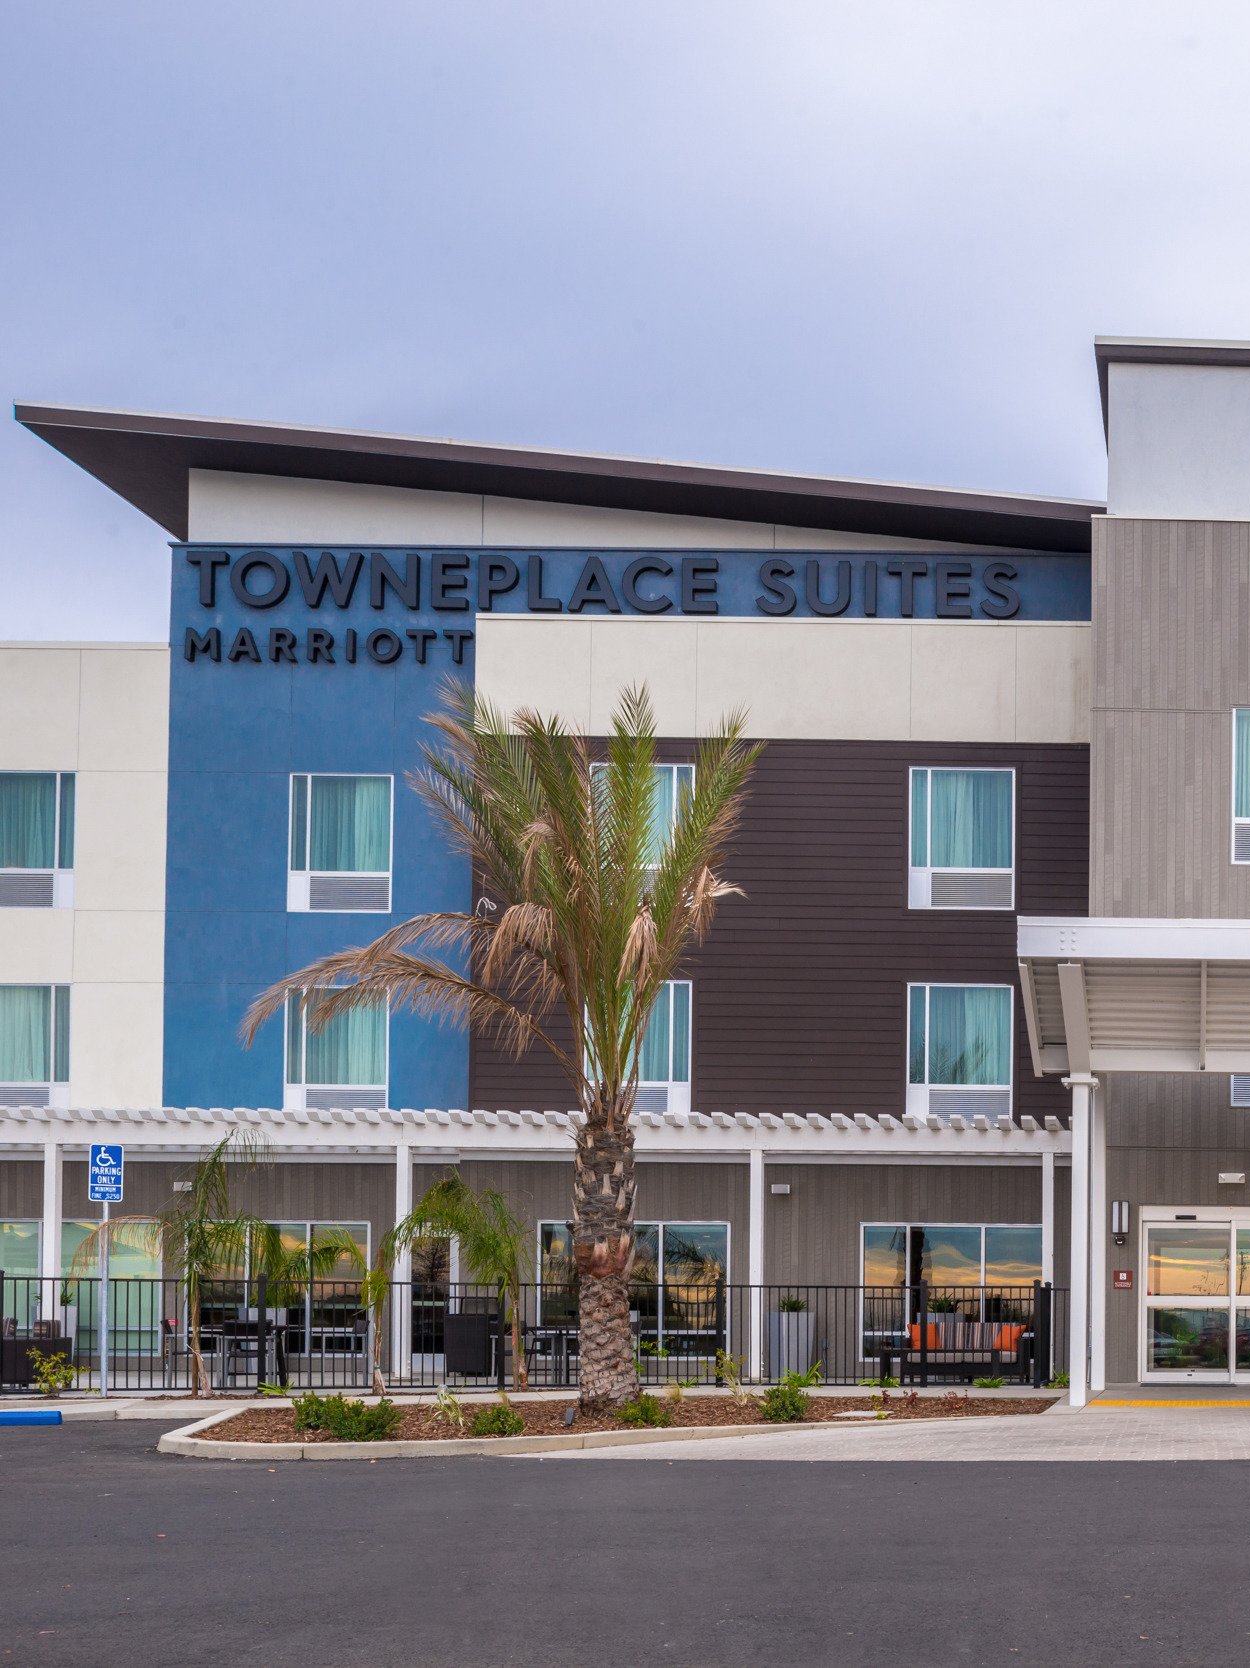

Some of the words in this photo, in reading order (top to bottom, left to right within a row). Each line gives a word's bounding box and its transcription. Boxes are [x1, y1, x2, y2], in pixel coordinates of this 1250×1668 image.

[186, 551, 719, 614] TOWNEPLACE
[755, 558, 1021, 620] SUITES
[184, 627, 473, 665] MARRIOTT
[92, 1166, 121, 1175] PARKING
[97, 1175, 115, 1184] ONLY
